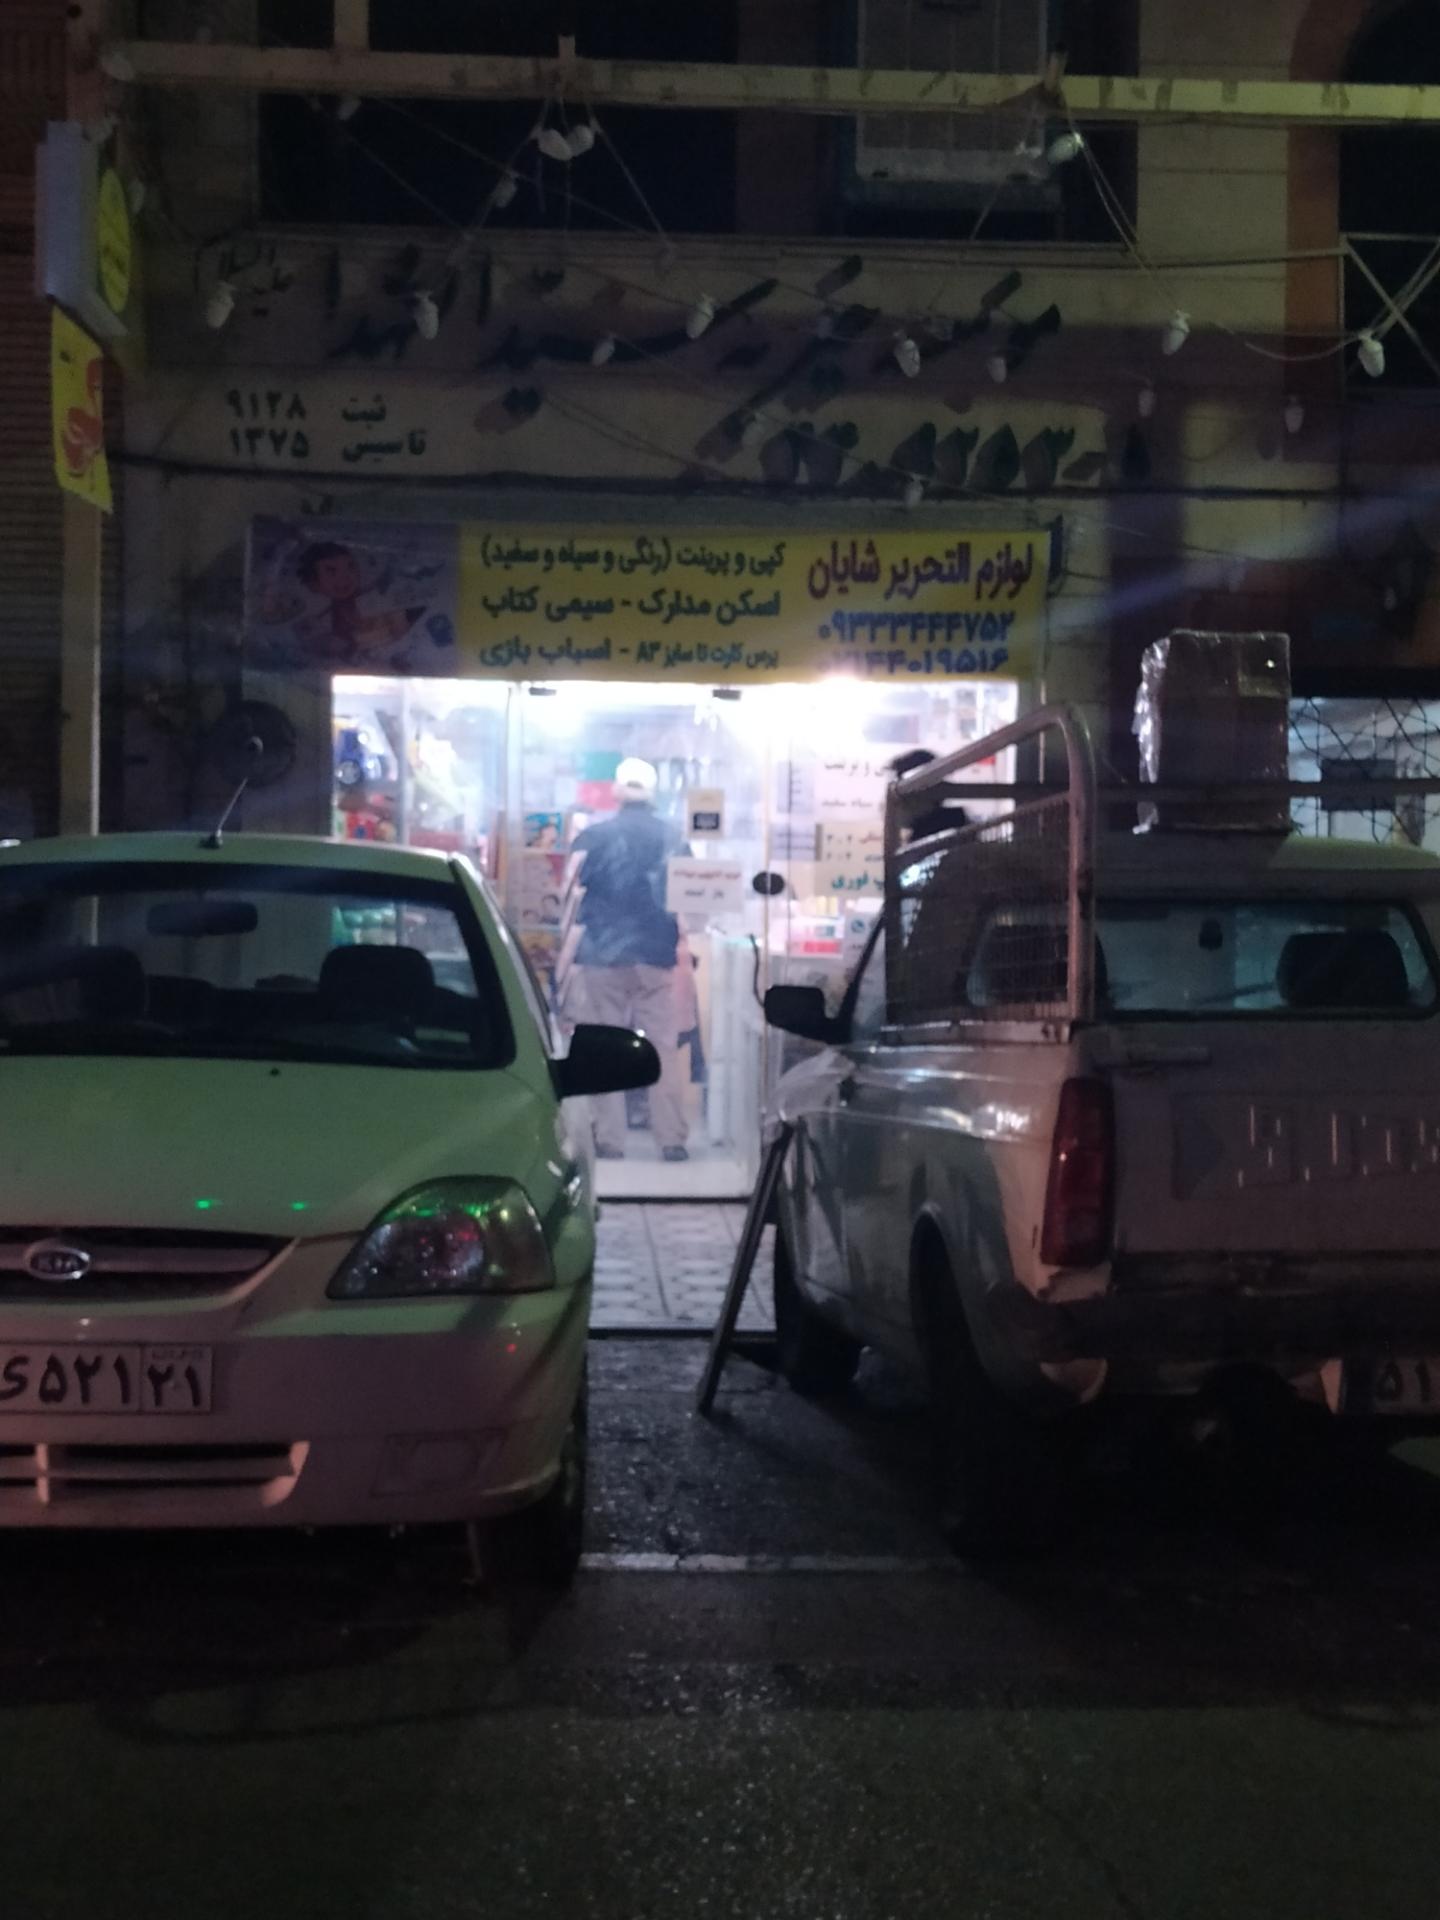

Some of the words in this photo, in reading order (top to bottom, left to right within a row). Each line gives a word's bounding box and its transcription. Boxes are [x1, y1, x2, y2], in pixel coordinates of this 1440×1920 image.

[226, 388, 306, 420] ۹۱۲۸
[342, 393, 387, 429] ثبت
[229, 427, 310, 459] ۱۳۷۵
[542, 550, 554, 572] و
[557, 539, 600, 571] سیاه
[603, 550, 615, 574] و
[676, 544, 730, 576] پرینت
[734, 551, 746, 574] و
[749, 541, 787, 576] کپی
[808, 540, 882, 600] شایان
[884, 541, 972, 601] التحریر
[975, 541, 1034, 601] لوازم
[481, 585, 541, 619] کتاب
[545, 597, 615, 623] سیمی
[638, 588, 712, 625] مدارک
[716, 589, 782, 626] اسکن
[479, 636, 533, 667] بازی
[538, 636, 613, 661] اسباب
[147, 1363, 202, 1407] ۲۱
